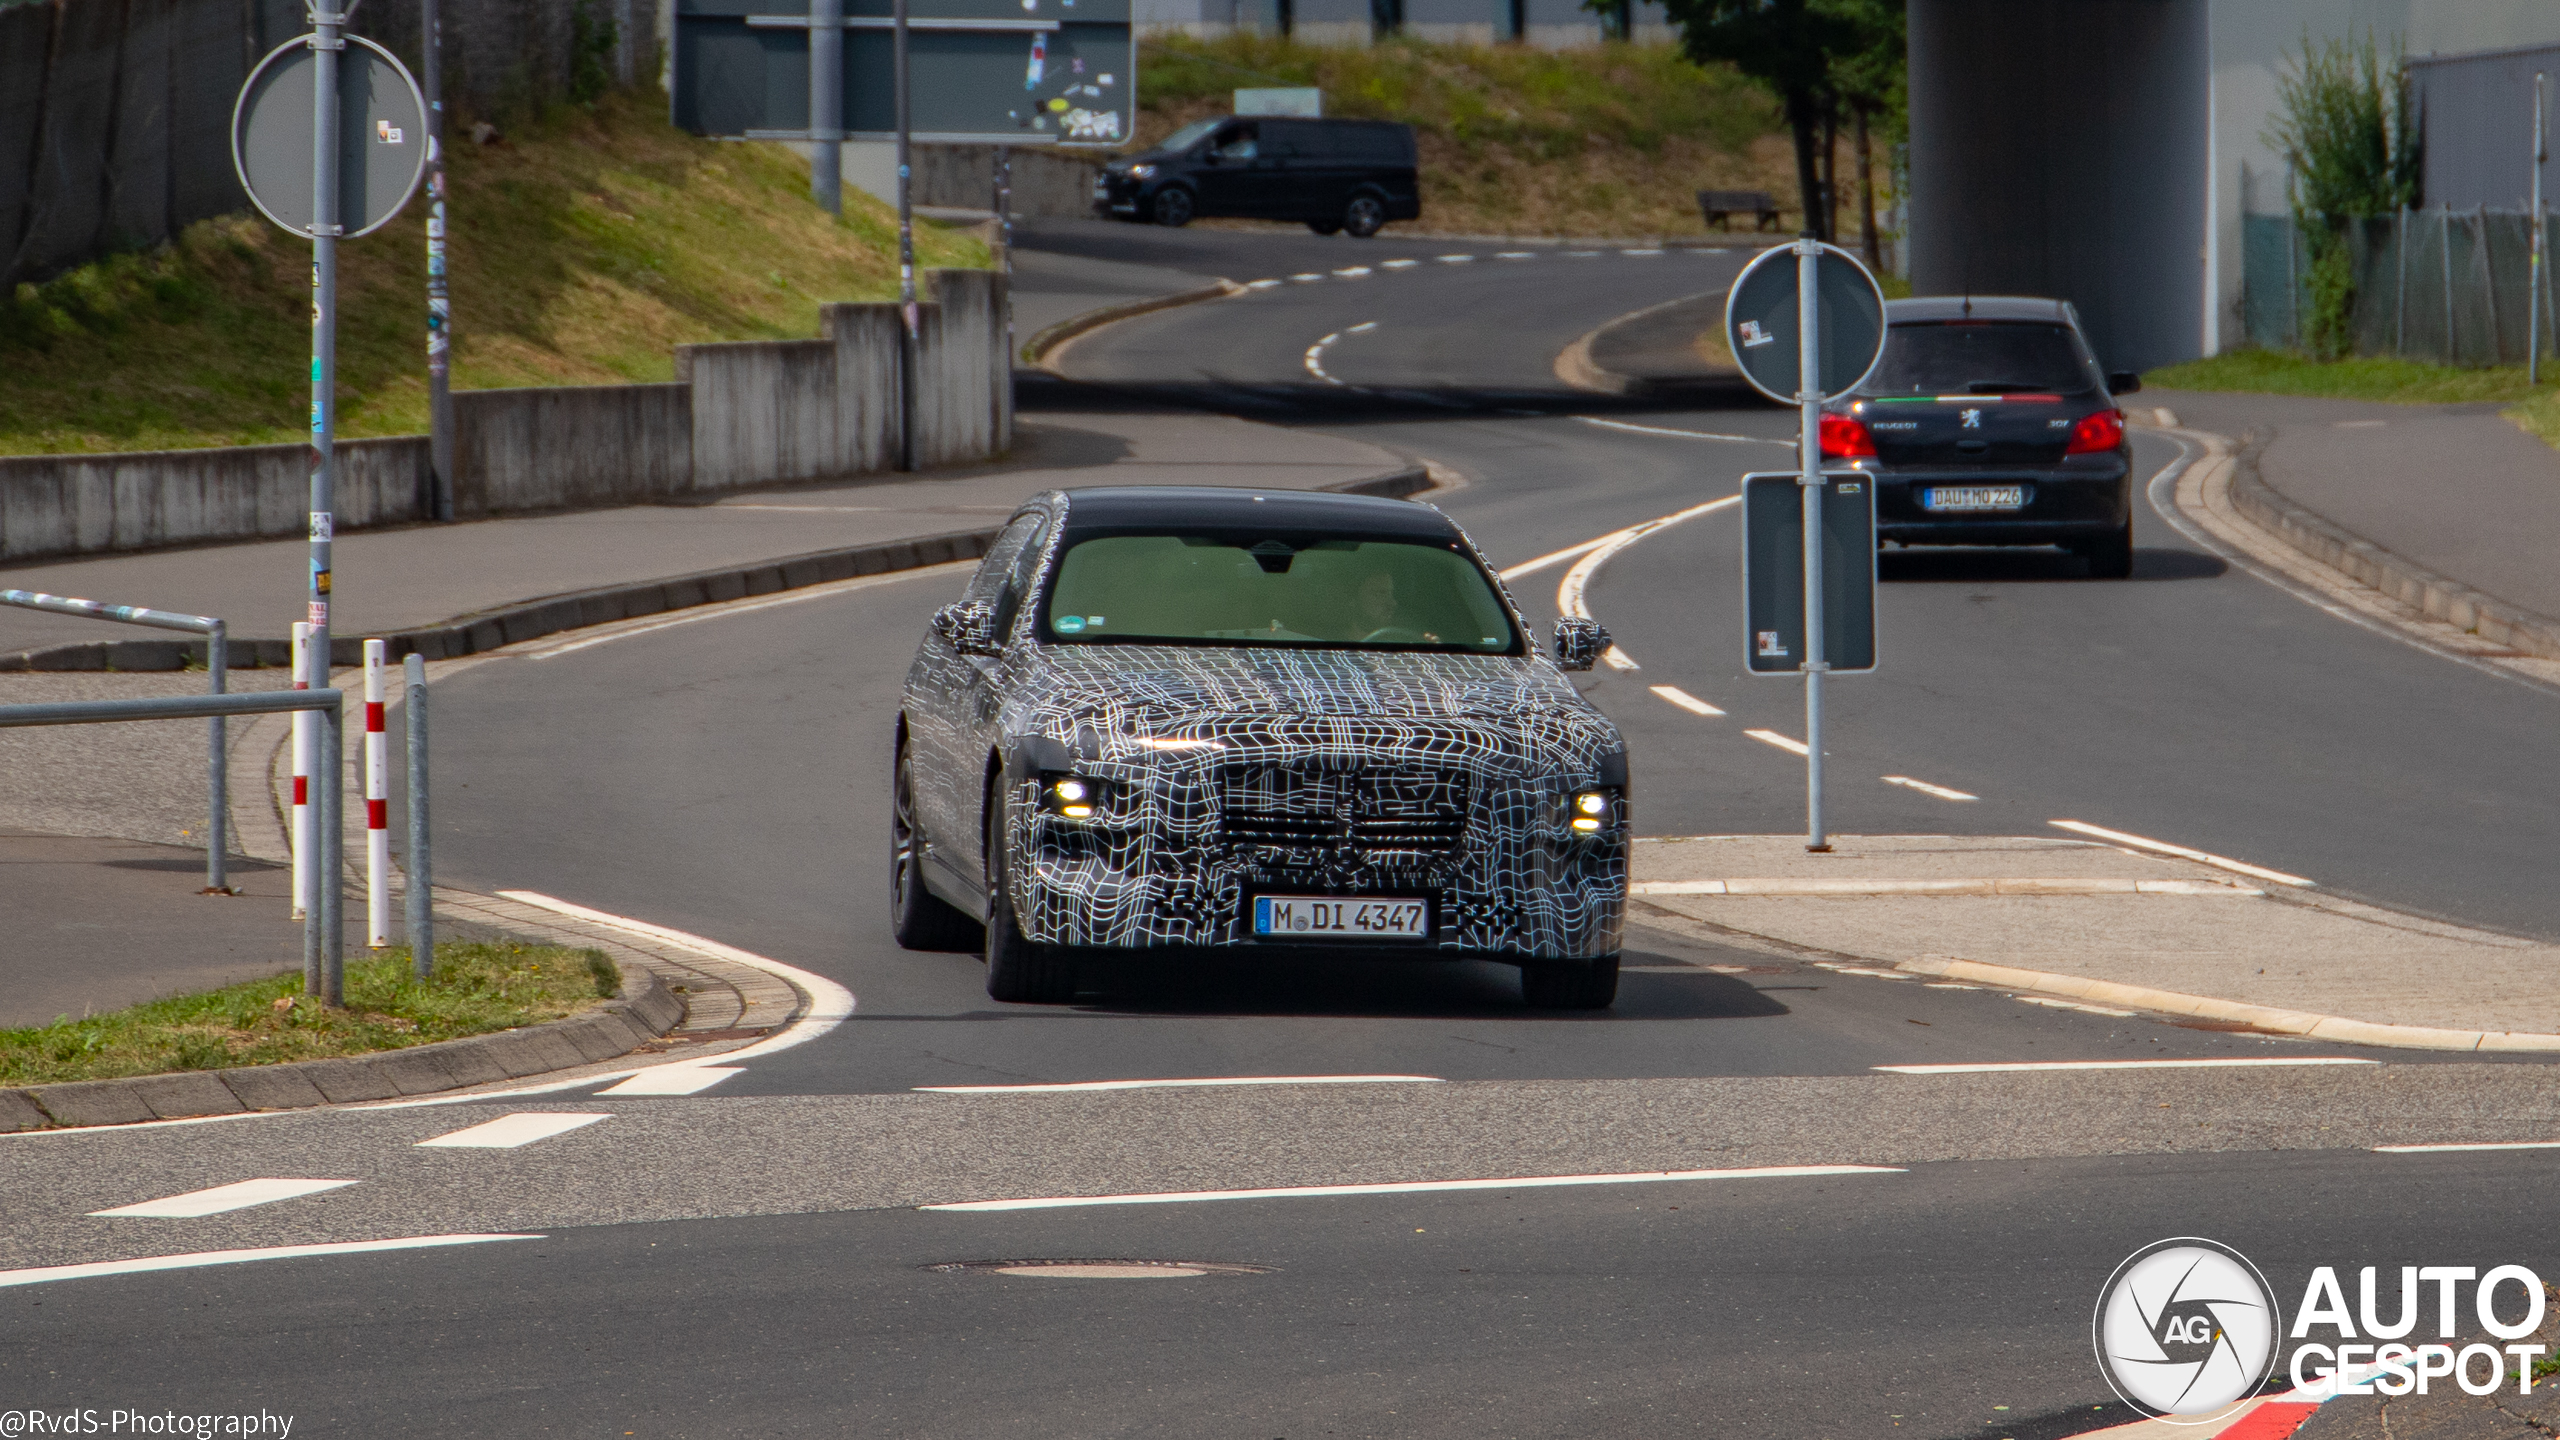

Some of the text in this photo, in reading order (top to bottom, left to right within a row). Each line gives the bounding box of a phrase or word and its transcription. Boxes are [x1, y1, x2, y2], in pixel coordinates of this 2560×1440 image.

[1935, 488, 2020, 505] DAU MO 226
[1274, 903, 1422, 931] M DI 4347
